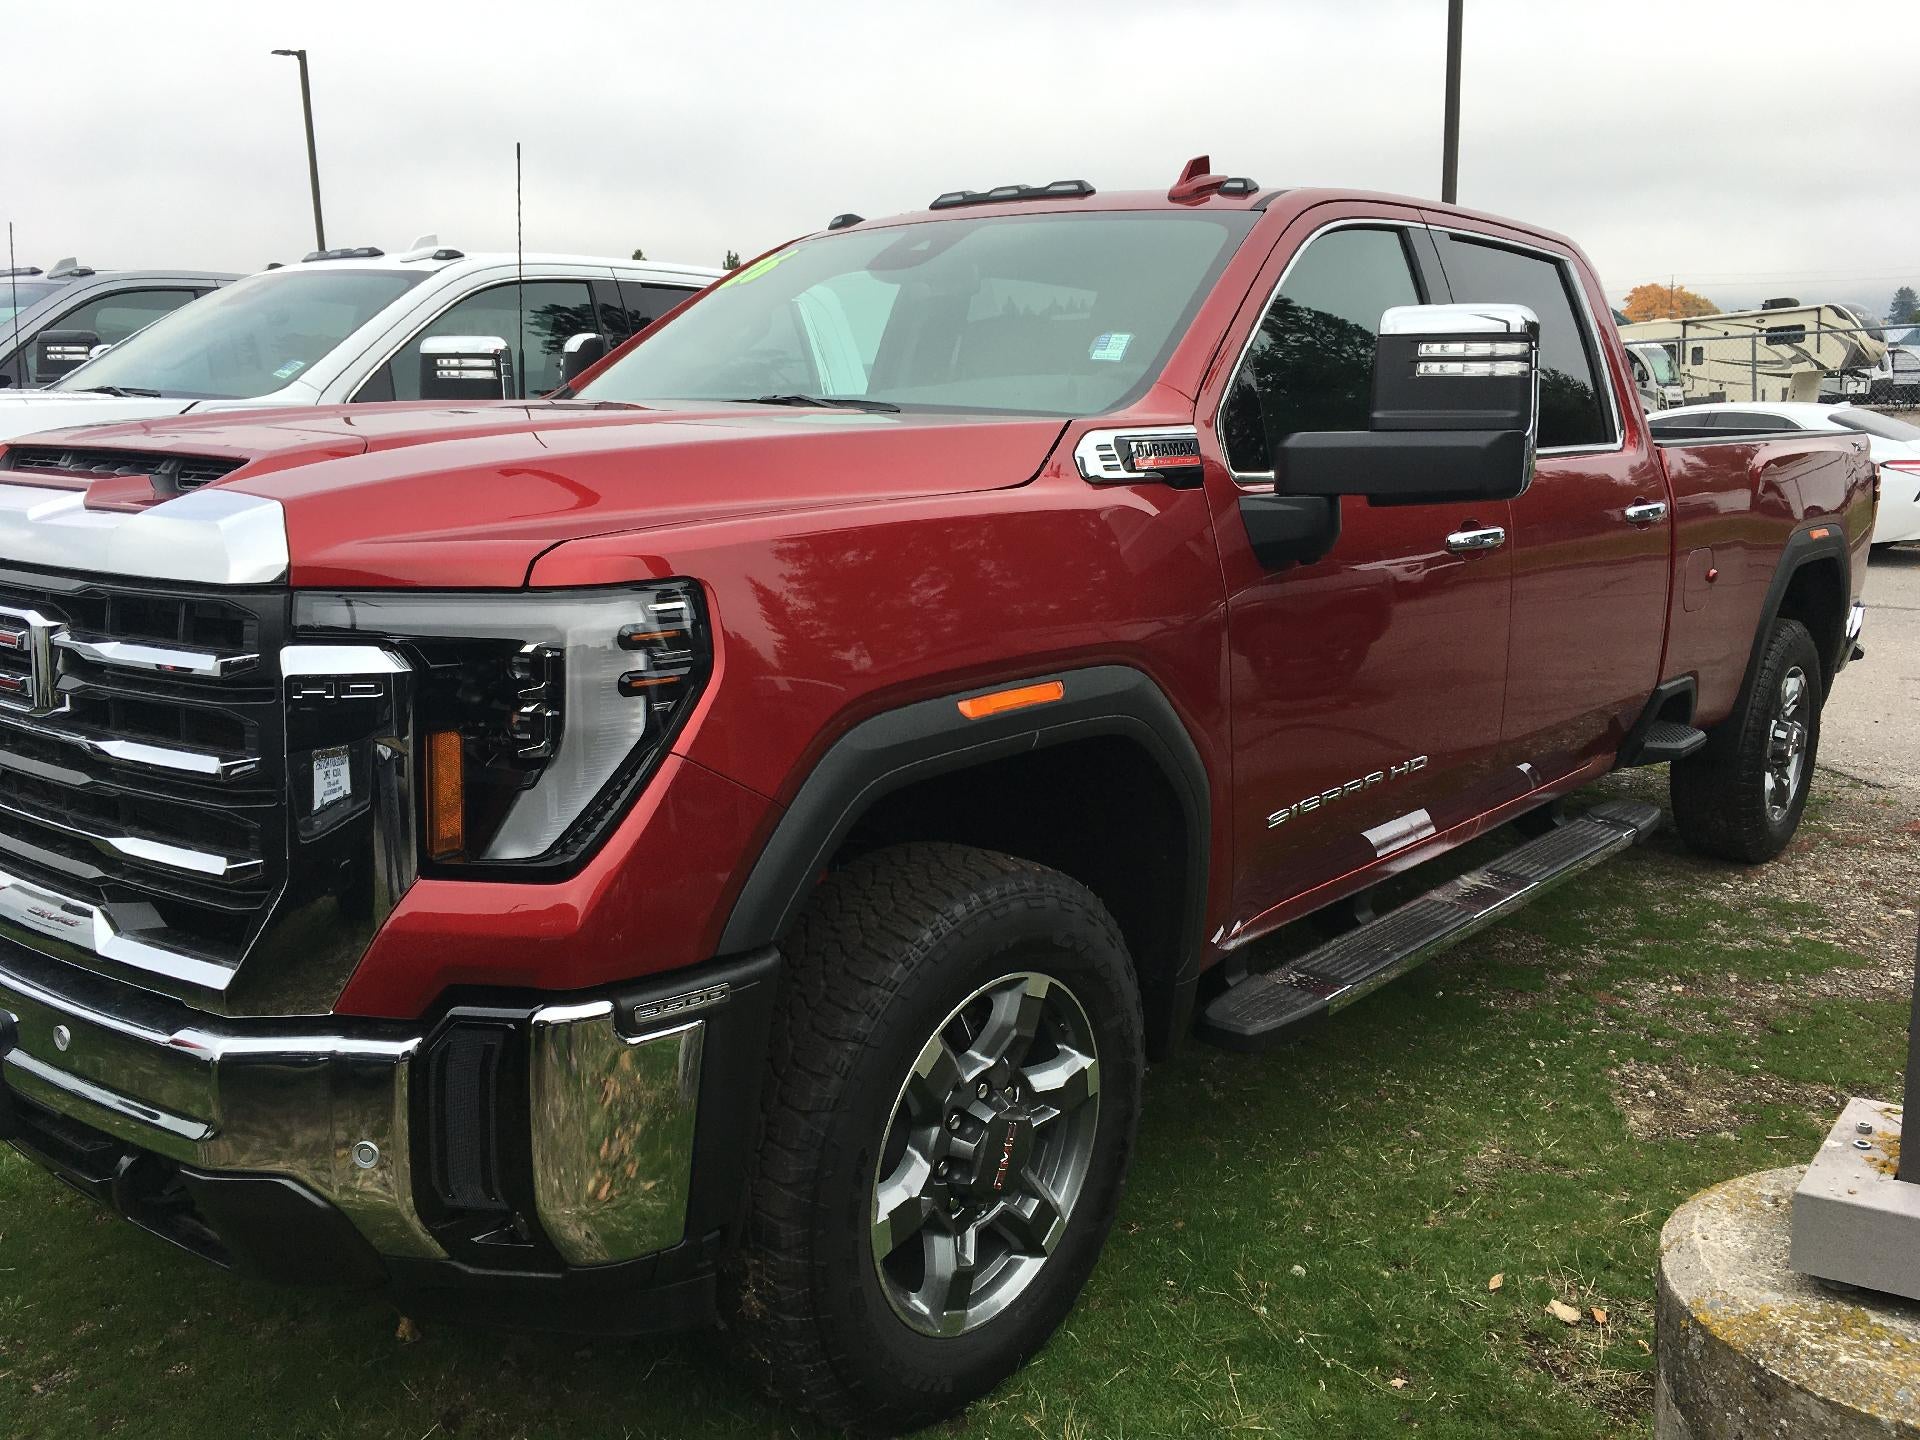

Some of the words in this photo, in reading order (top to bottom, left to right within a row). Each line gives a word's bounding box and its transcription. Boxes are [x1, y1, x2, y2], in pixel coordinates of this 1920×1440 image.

[1135, 441, 1194, 457] DURAMAX
[292, 681, 384, 699] HD
[1266, 771, 1384, 828] SIERRA
[1390, 755, 1428, 780] HD
